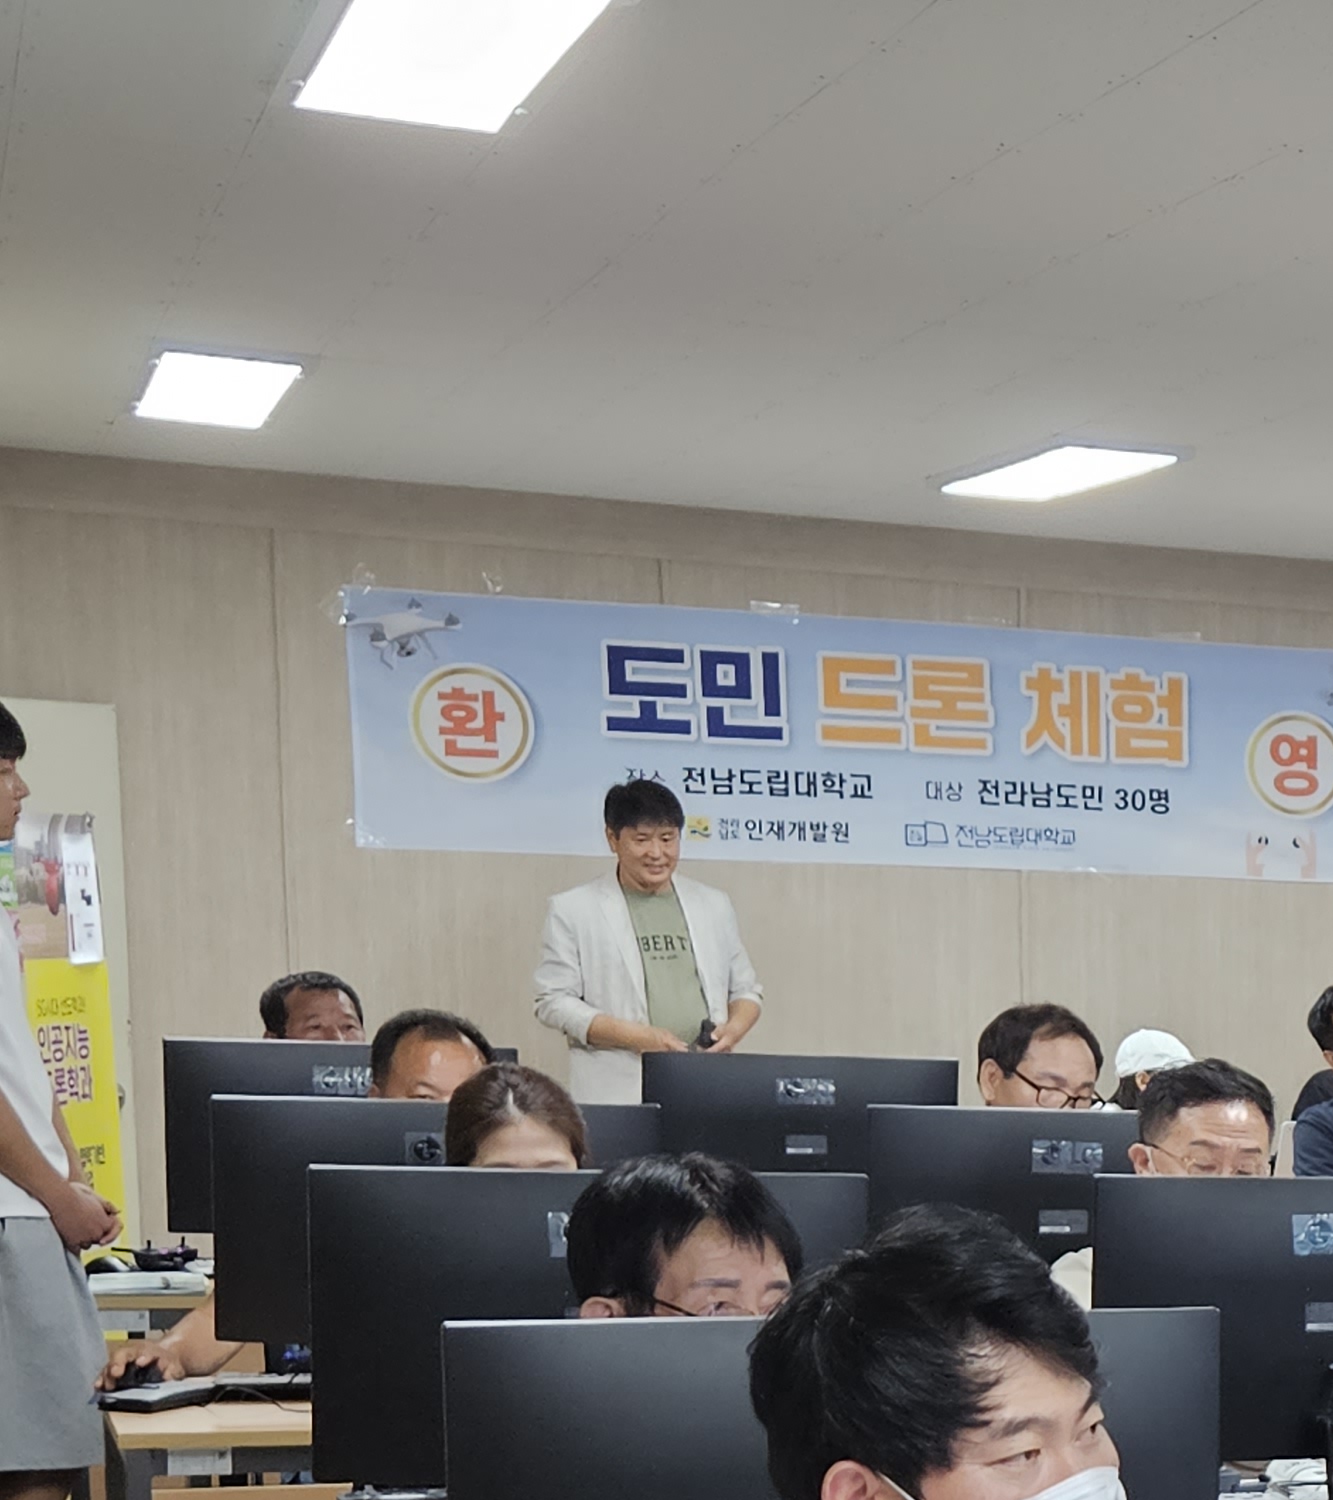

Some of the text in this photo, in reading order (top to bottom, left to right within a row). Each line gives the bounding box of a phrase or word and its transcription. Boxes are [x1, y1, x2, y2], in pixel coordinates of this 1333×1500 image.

[436, 687, 505, 760] 환
[605, 643, 1185, 763] 도민 드론 체험
[682, 767, 874, 800] 전남도립대학교
[1267, 735, 1322, 797] 영
[925, 778, 1171, 816] 대상 전라남도민 30명
[744, 819, 850, 844] 인재개발원
[955, 824, 1077, 848] 전남도립대학교
[37, 1023, 90, 1064] 인공지능
[48, 1063, 93, 1105] 론학과
